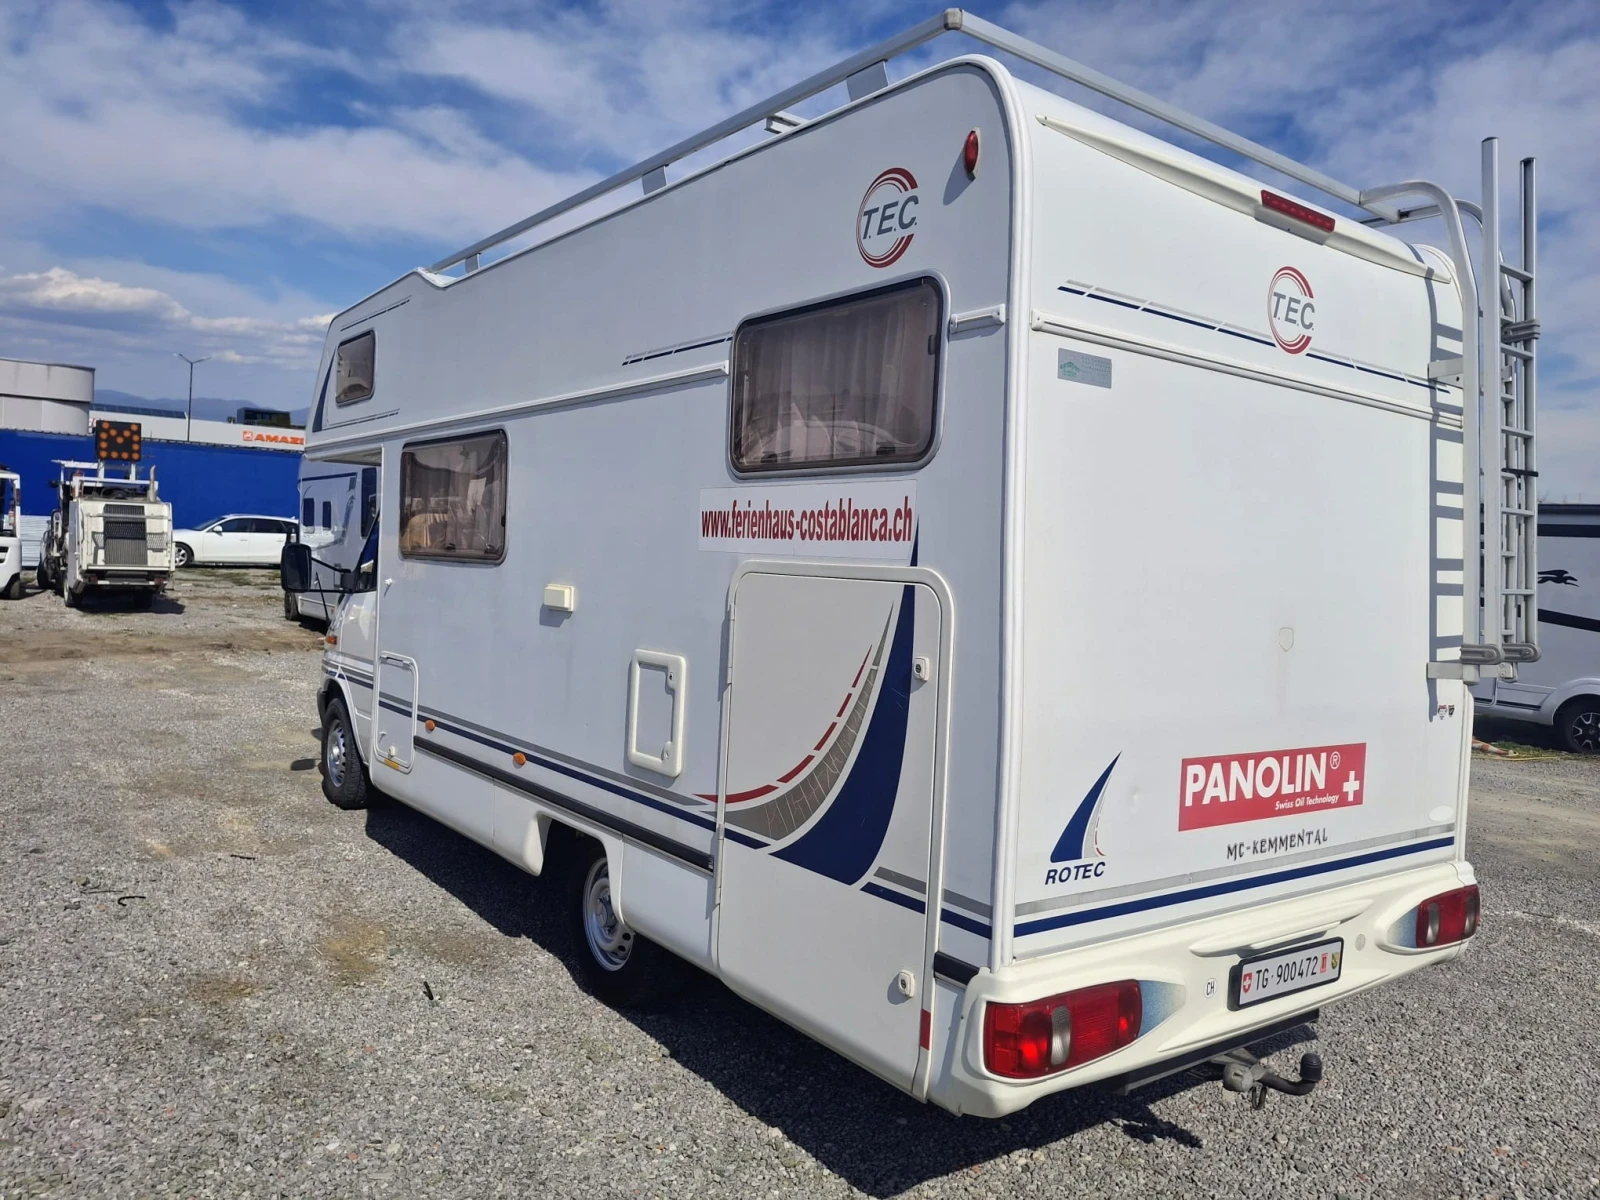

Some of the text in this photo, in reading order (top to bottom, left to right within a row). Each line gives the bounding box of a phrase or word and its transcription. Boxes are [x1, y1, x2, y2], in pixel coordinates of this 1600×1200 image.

[701, 495, 913, 542] www.ferienhaus-costablanca.ch
[1274, 793, 1340, 811] Swiss Oil Technology
[1226, 827, 1329, 862] MC-KEMMENTAL
[1045, 861, 1106, 886] ROTEC
[1206, 980, 1215, 996] CH
